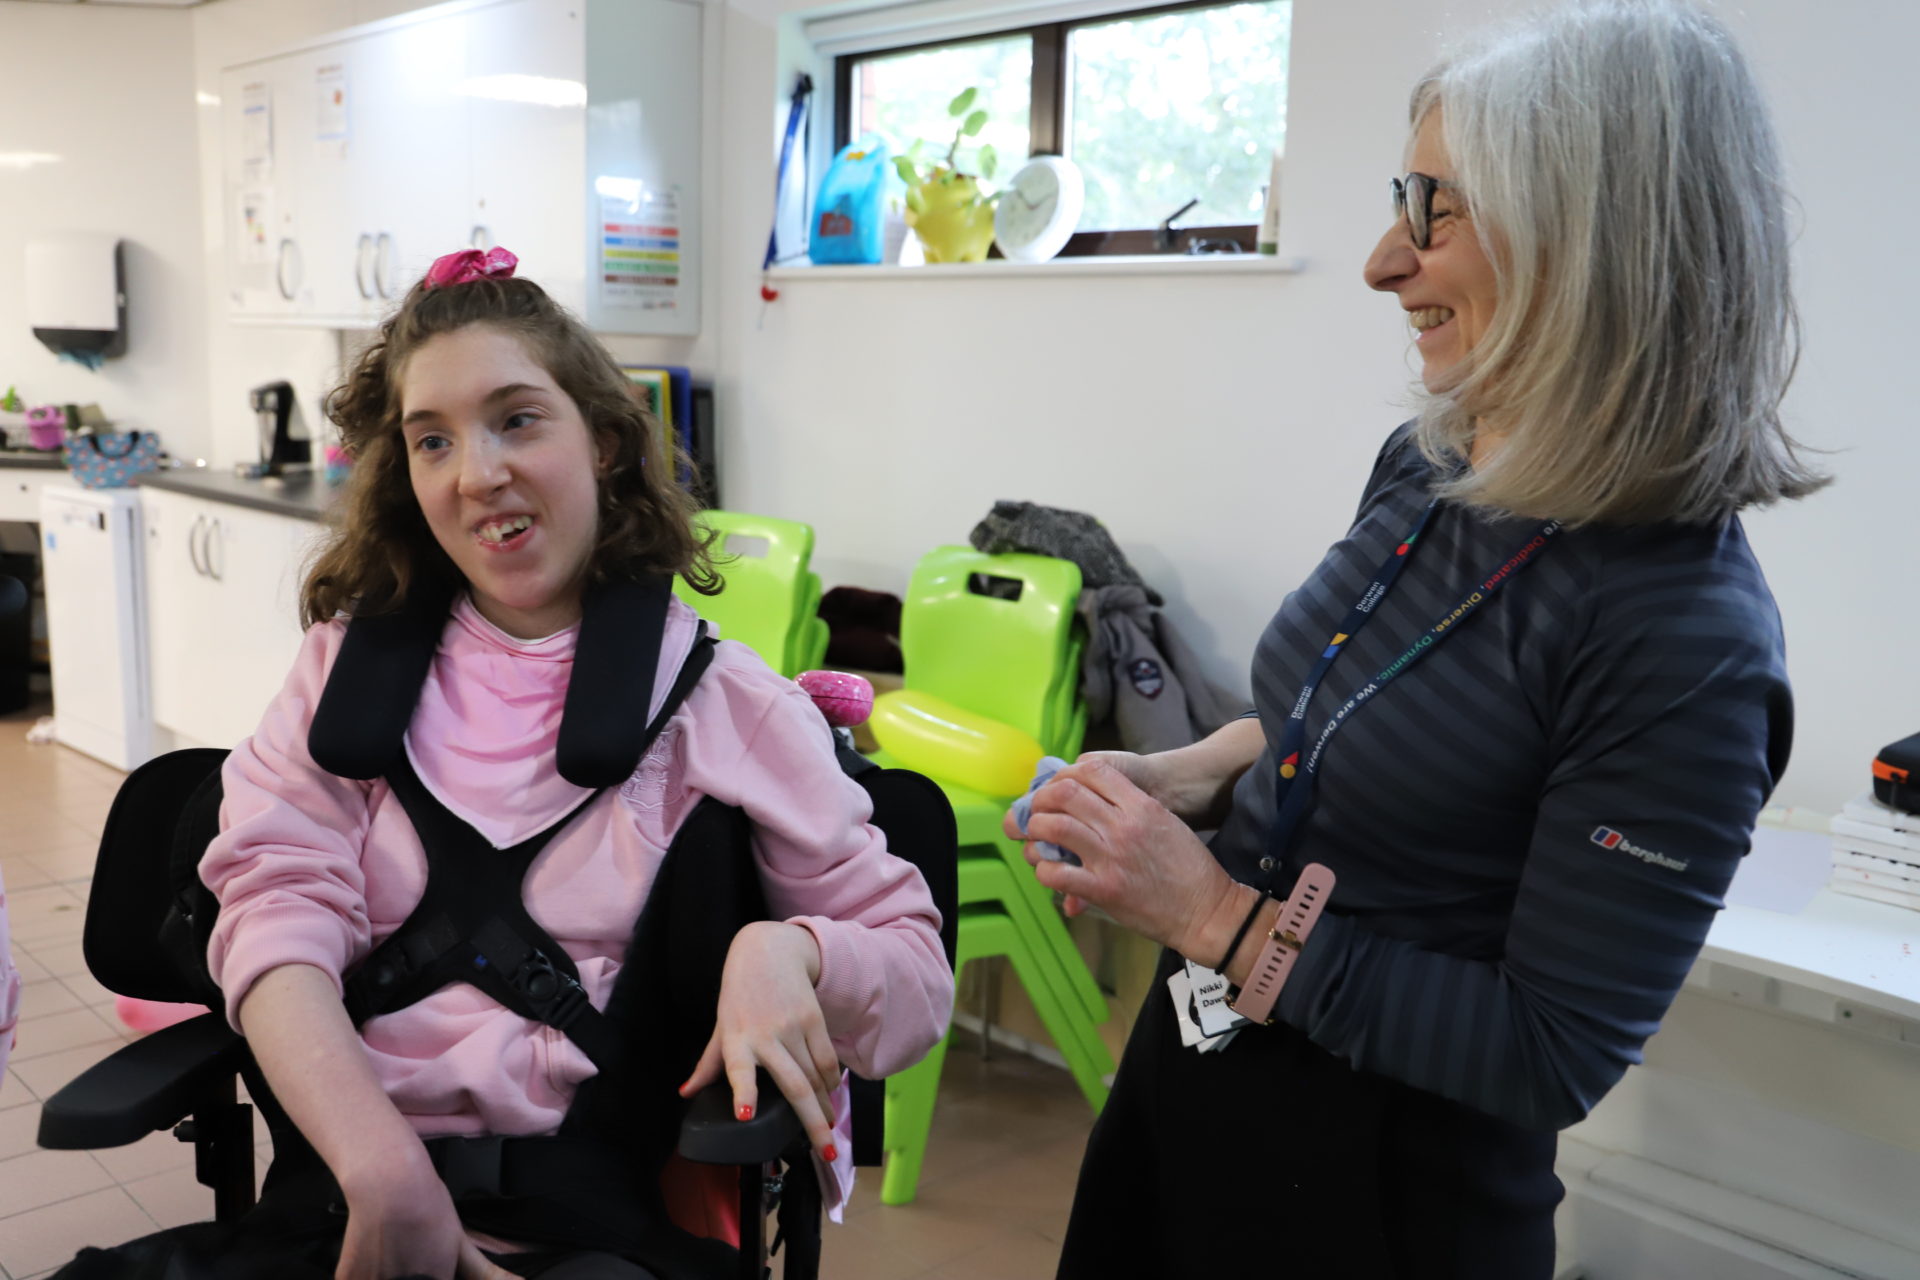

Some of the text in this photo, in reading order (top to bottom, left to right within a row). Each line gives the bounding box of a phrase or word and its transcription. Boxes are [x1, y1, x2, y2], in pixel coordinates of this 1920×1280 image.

[1480, 535, 1545, 590] Dedicated,
[1355, 581, 1381, 611] Derwen
[1361, 584, 1386, 613] College
[1432, 592, 1483, 633] Diverse,
[1376, 635, 1433, 681] Dynamic.
[1291, 685, 1310, 719] Derwen
[1356, 683, 1378, 701] We
[1336, 700, 1355, 719] are
[1306, 720, 1337, 773] Derwen!
[1200, 981, 1223, 995] Nikki
